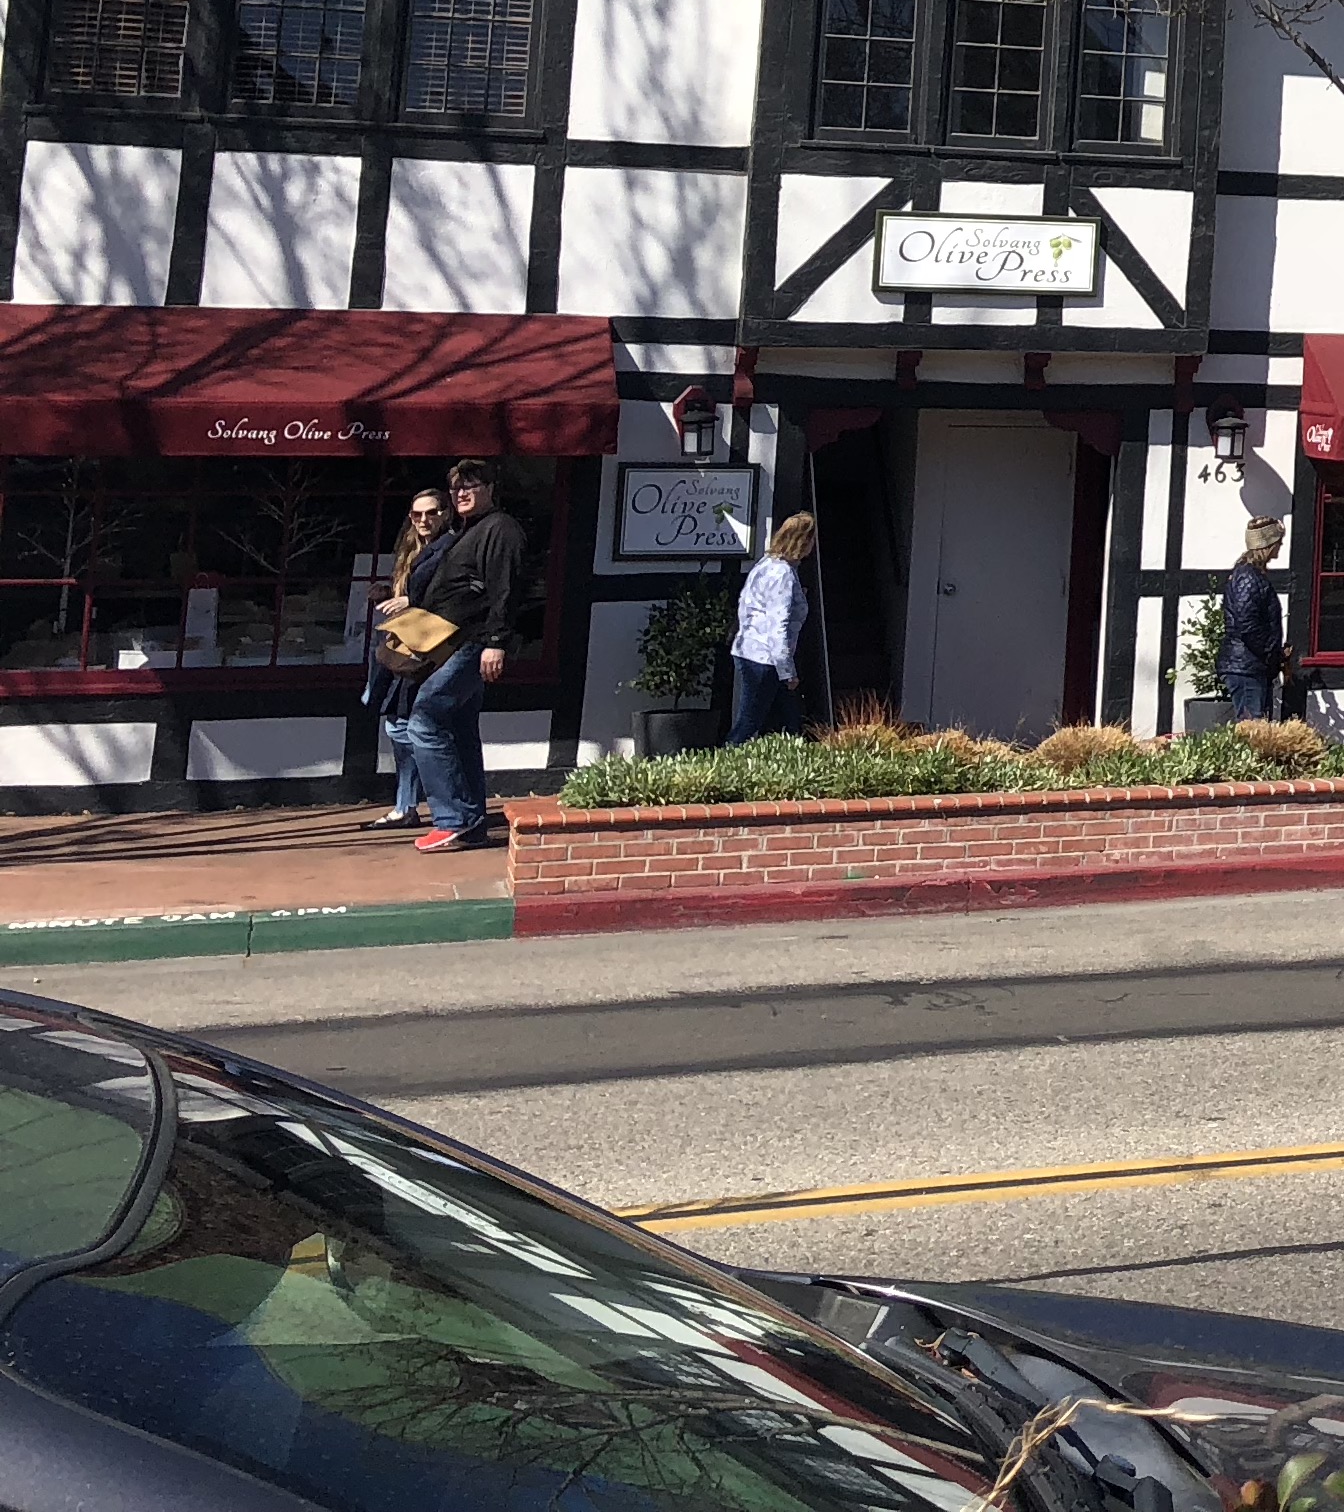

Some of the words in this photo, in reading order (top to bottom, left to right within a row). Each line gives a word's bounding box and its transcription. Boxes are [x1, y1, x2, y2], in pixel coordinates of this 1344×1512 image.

[899, 227, 988, 264] Olive
[966, 227, 1041, 255] Solvang
[975, 250, 1072, 283] Press
[207, 418, 276, 445] Solvang
[284, 419, 331, 439] Olive
[338, 421, 390, 440] Press
[1198, 461, 1245, 484] 463
[631, 480, 707, 515] Olive
[686, 476, 740, 500] Solvang
[655, 514, 738, 546] Press
[8, 916, 144, 930] MINUTE
